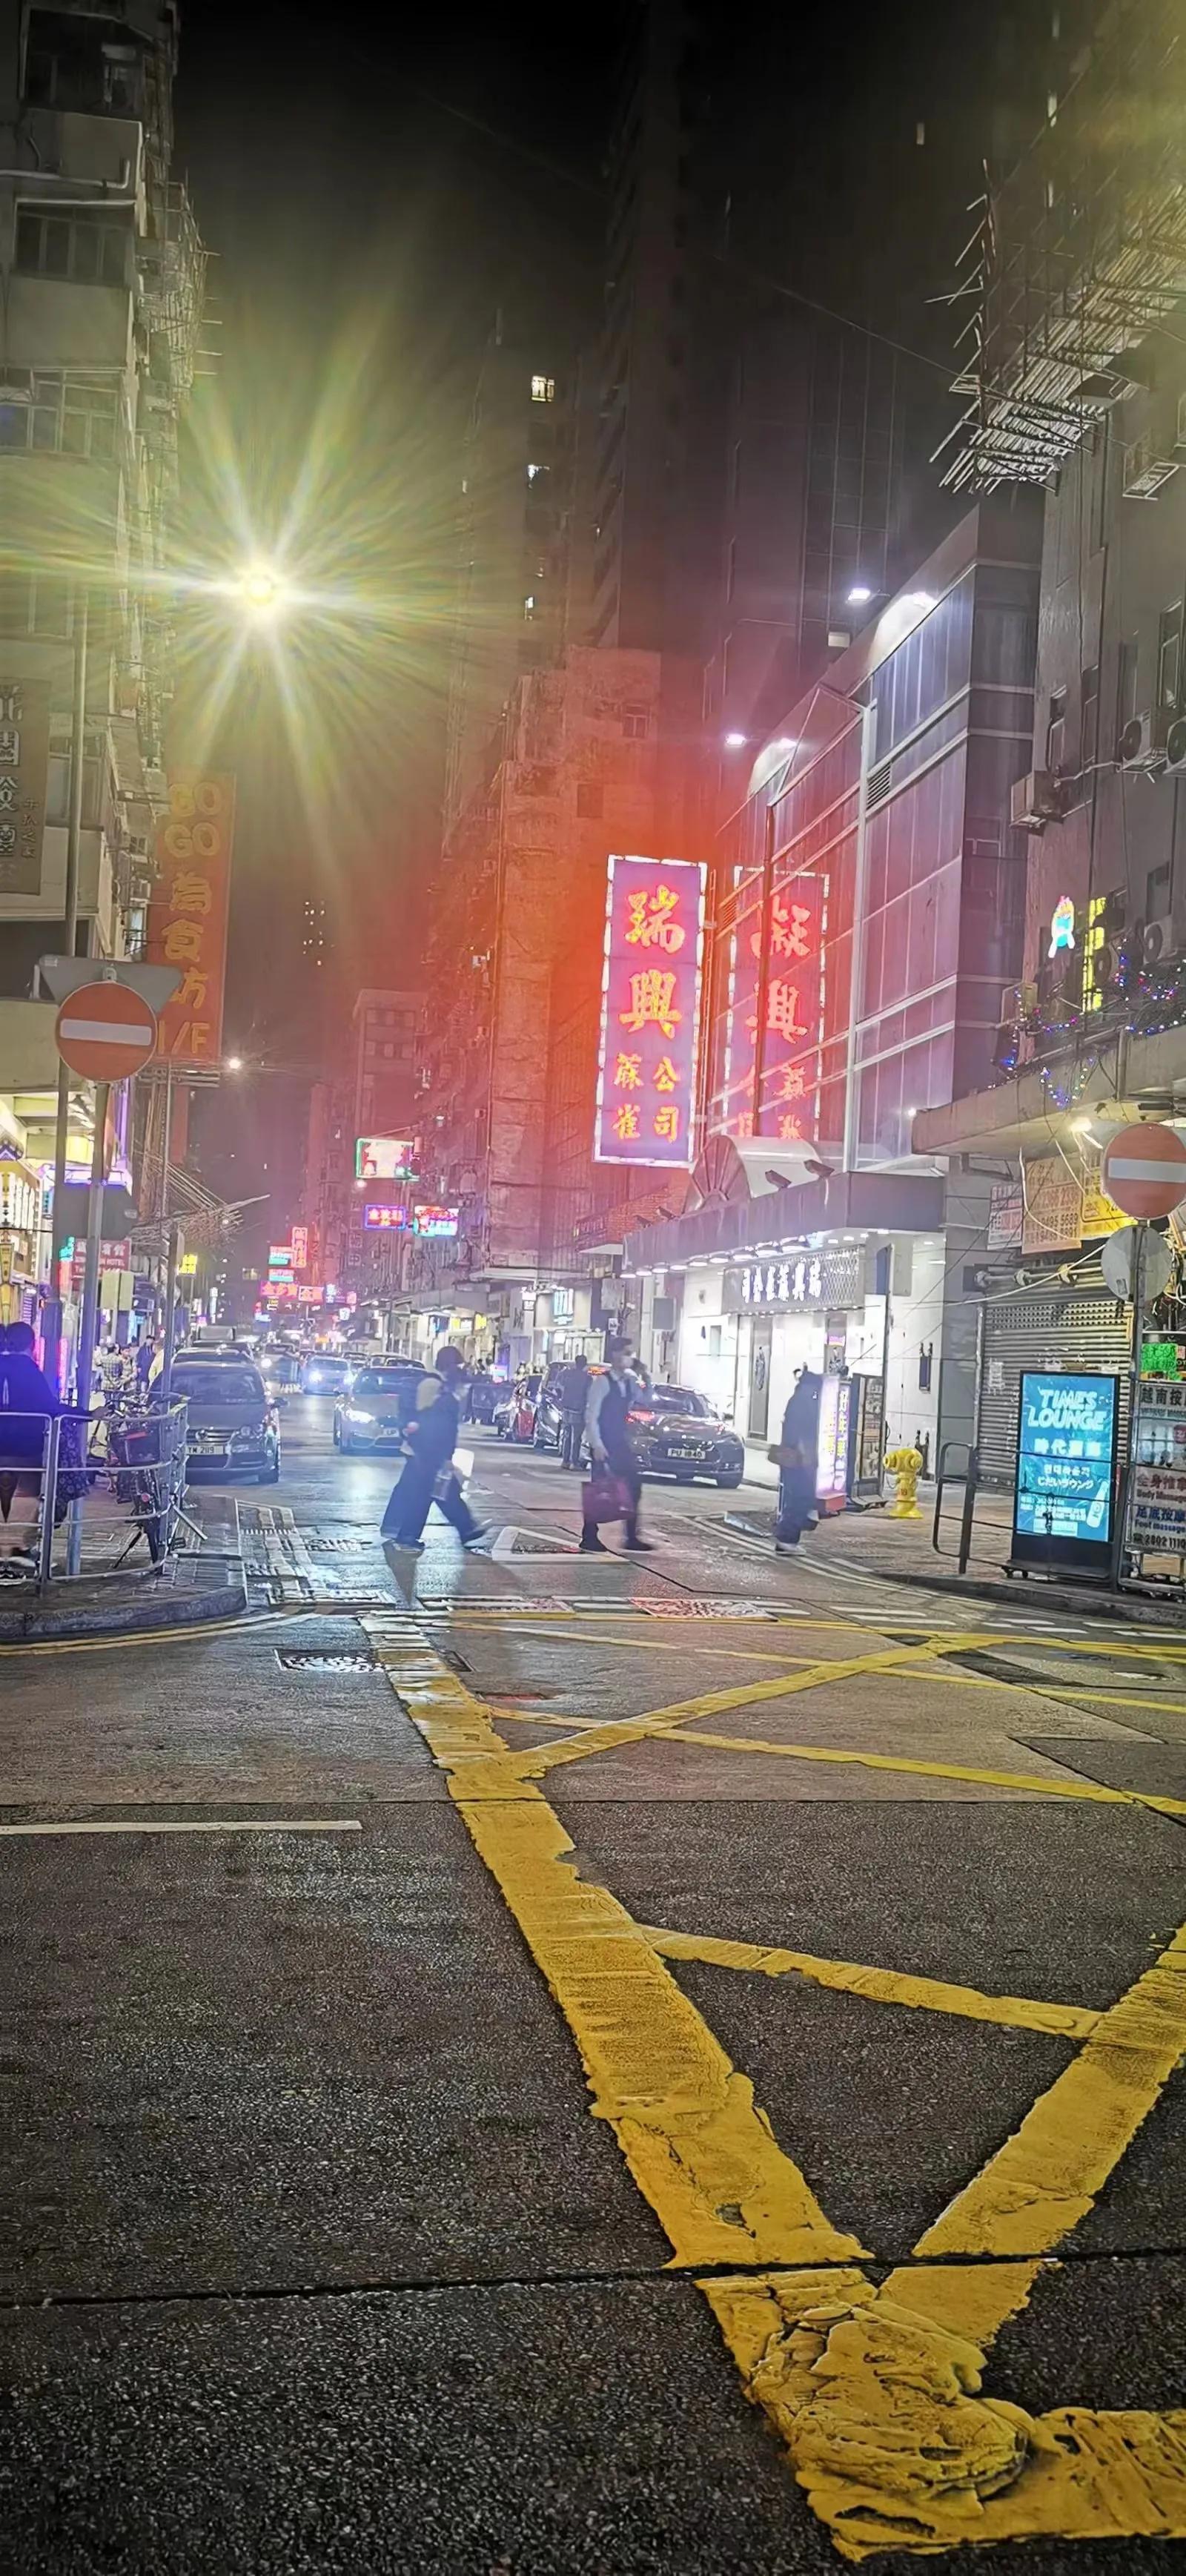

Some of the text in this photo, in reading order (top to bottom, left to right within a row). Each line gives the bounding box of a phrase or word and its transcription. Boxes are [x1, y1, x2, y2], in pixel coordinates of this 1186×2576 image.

[169, 782, 222, 817] GO
[165, 823, 220, 859] GO
[618, 884, 686, 1040] 瑞興
[652, 1056, 682, 1143] 公司
[1038, 1386, 1097, 1410] TIMES
[1142, 1387, 1186, 1406] 越南按
[1024, 1404, 1107, 1430] LOUNGE
